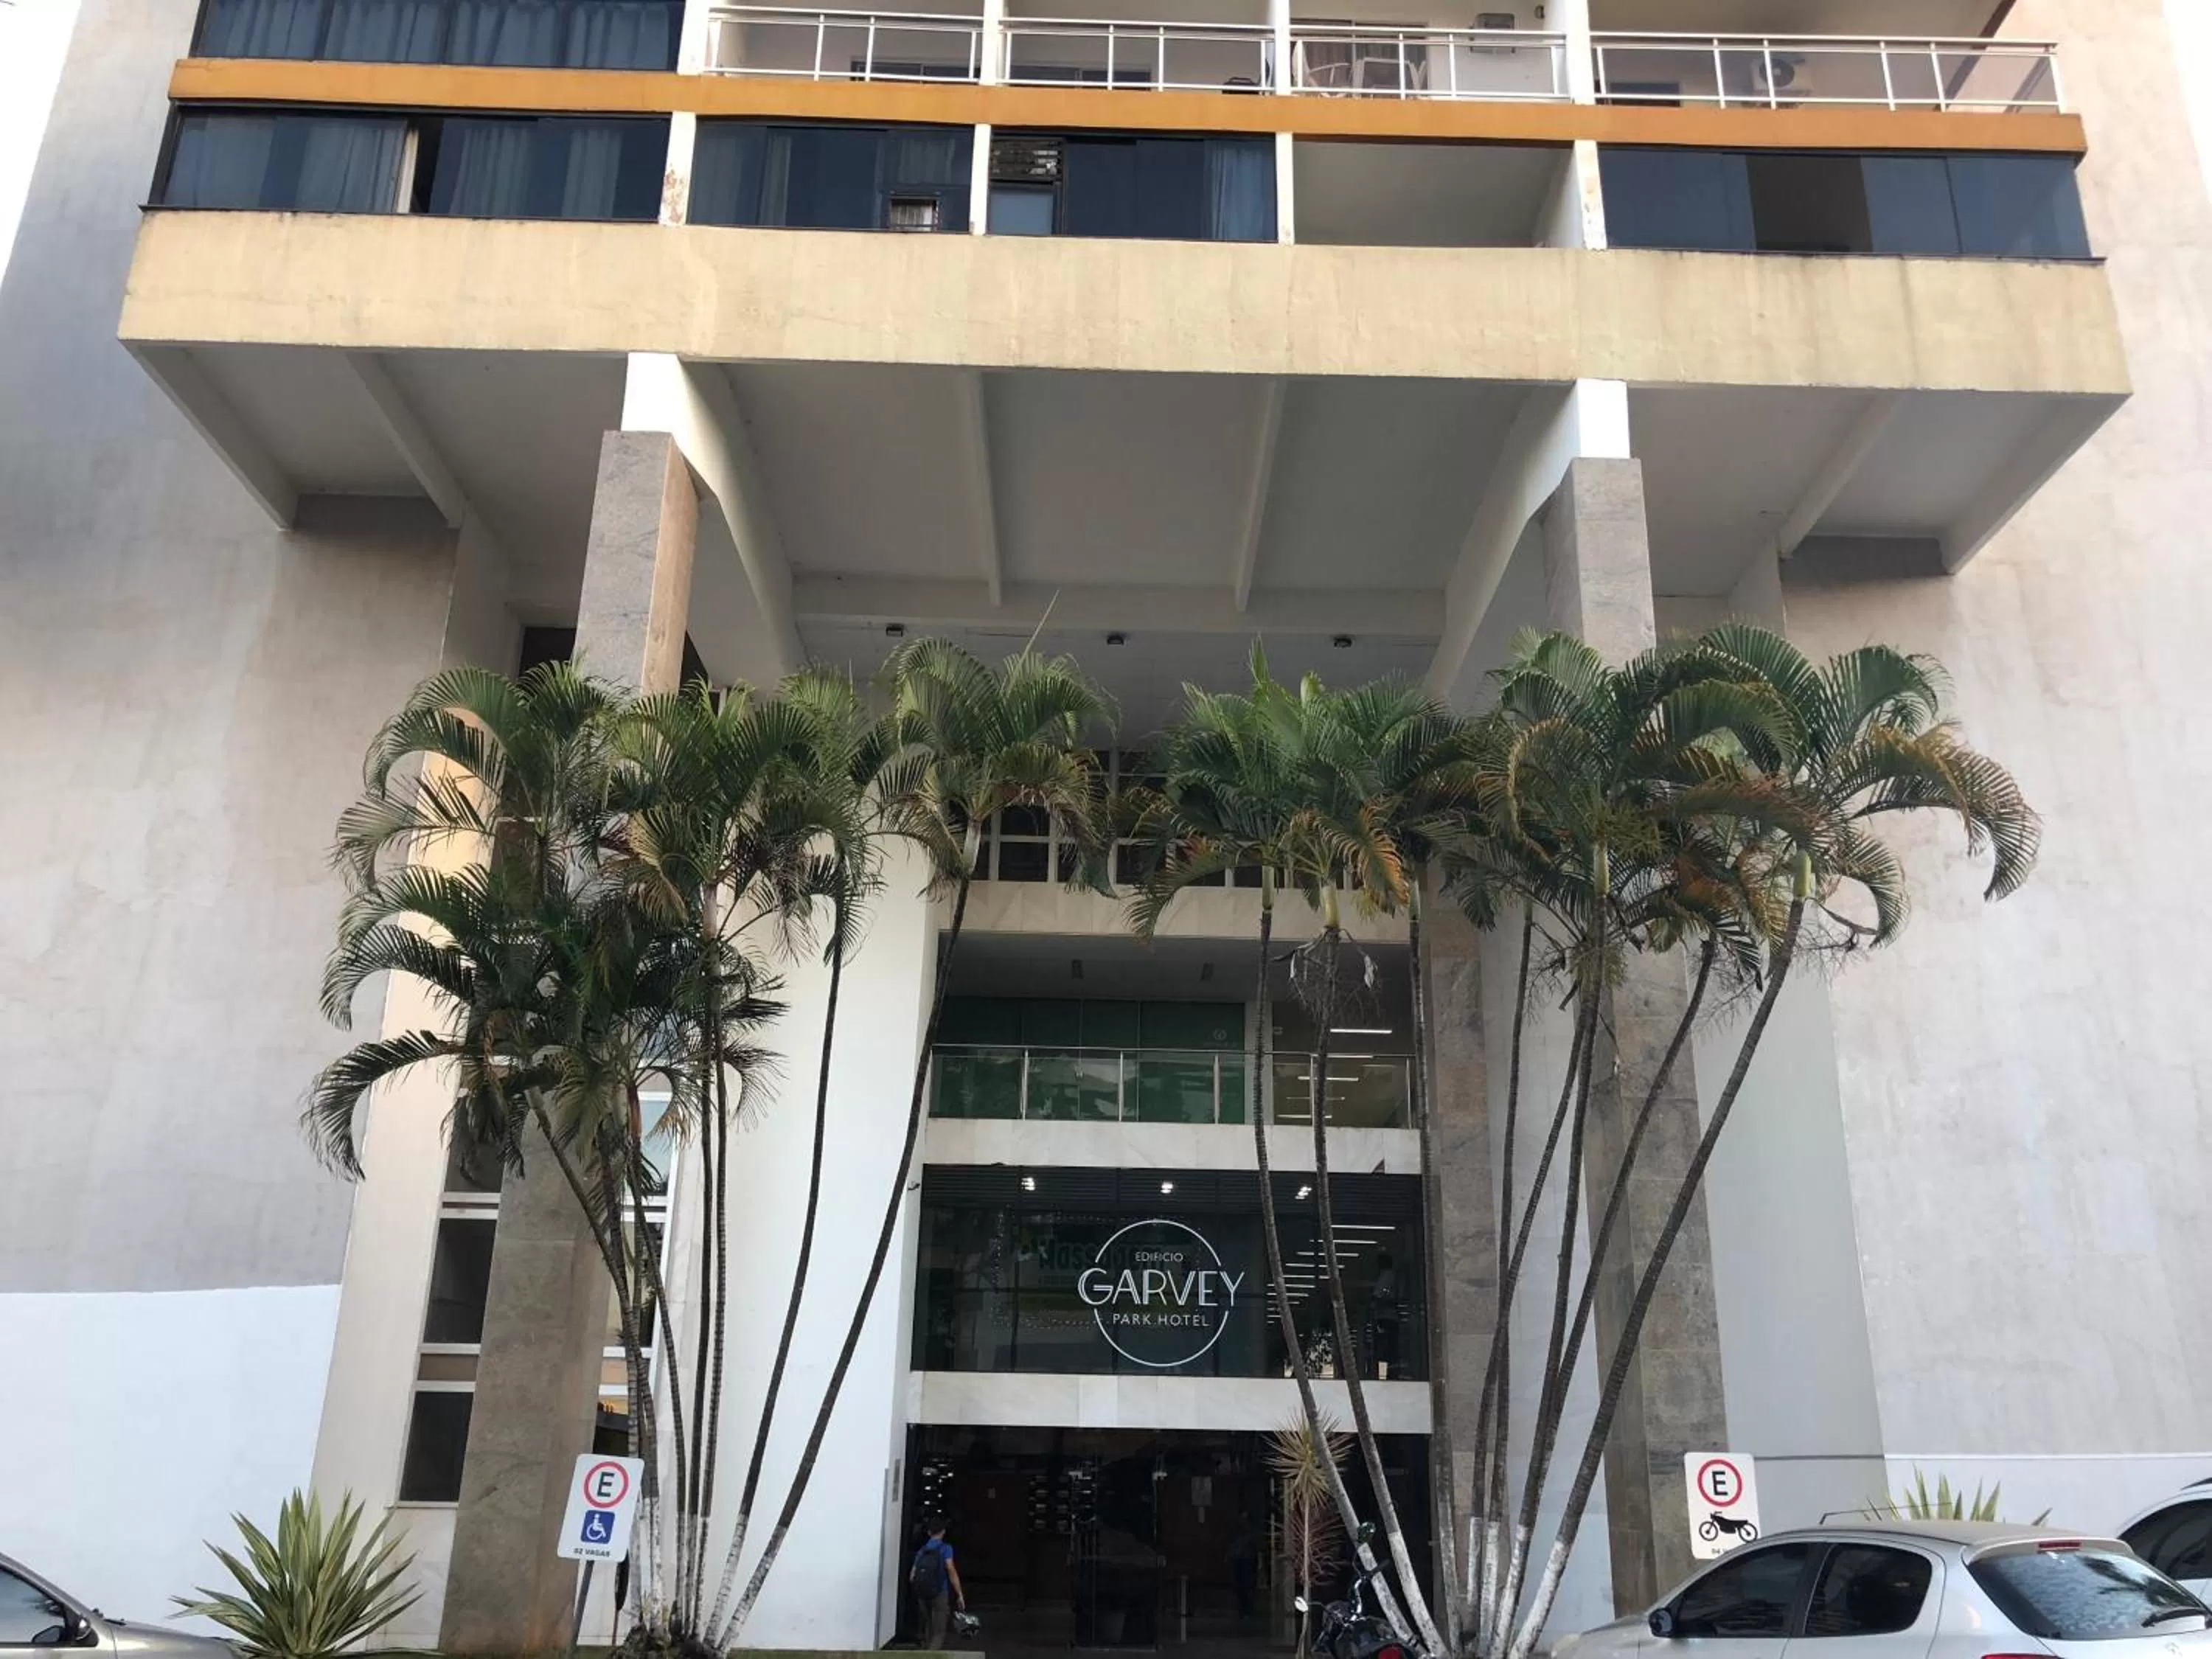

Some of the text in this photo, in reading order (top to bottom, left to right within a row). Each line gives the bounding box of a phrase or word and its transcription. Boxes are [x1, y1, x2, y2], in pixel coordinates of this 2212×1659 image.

[1077, 1267, 1245, 1307] GARVEY
[1112, 1312, 1210, 1327] PARK HOTEL
[597, 1471, 616, 1498] E
[1711, 1470, 1728, 1496] E
